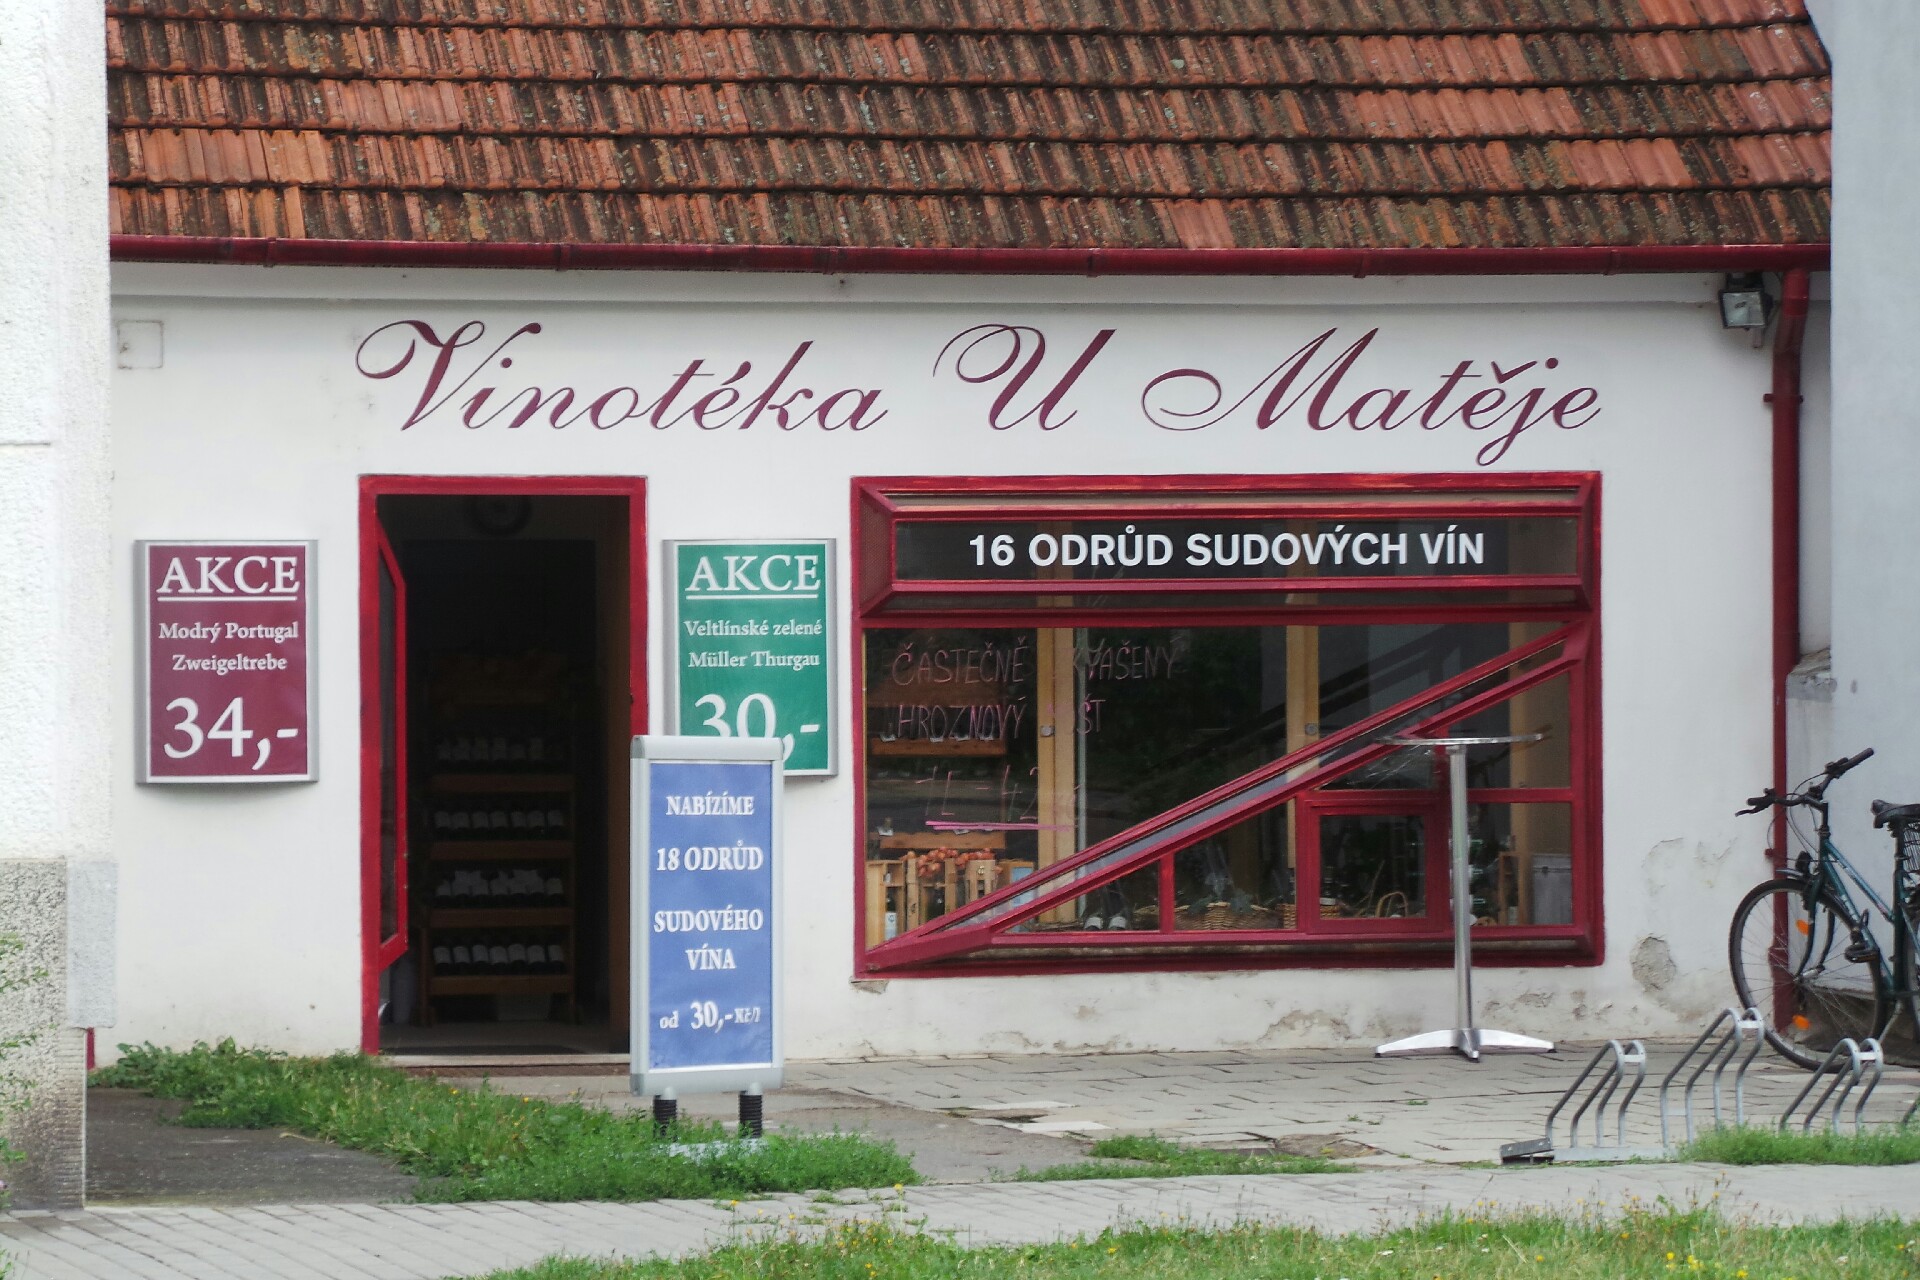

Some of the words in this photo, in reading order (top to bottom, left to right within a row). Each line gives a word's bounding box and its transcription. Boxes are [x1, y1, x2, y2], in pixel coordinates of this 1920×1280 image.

[356, 319, 889, 431] Vinotéka
[932, 324, 1117, 431] U
[1141, 327, 1602, 466] Matěje
[969, 533, 1016, 566] 16
[1028, 525, 1174, 566] ODRŮD
[1186, 525, 1408, 566] SUDOVÝCH
[1420, 525, 1485, 565] VÍN
[156, 555, 300, 594] AKCE
[685, 554, 821, 592] AKCE
[158, 622, 221, 644] Modrý
[224, 621, 299, 644] Portugal
[683, 619, 769, 637] Veltlínské
[773, 619, 823, 636] zelené
[171, 653, 288, 676] Zweigeltrebe
[687, 650, 748, 668] Müller
[751, 650, 820, 672] Thurgau
[163, 697, 299, 771] 34,-
[665, 791, 754, 816] NABÍZÍME
[656, 847, 680, 872] 18
[684, 839, 764, 872] ODRŮD
[653, 904, 764, 933] SUDOVÉHO
[685, 943, 736, 971] VÍNA
[659, 1010, 679, 1030] od
